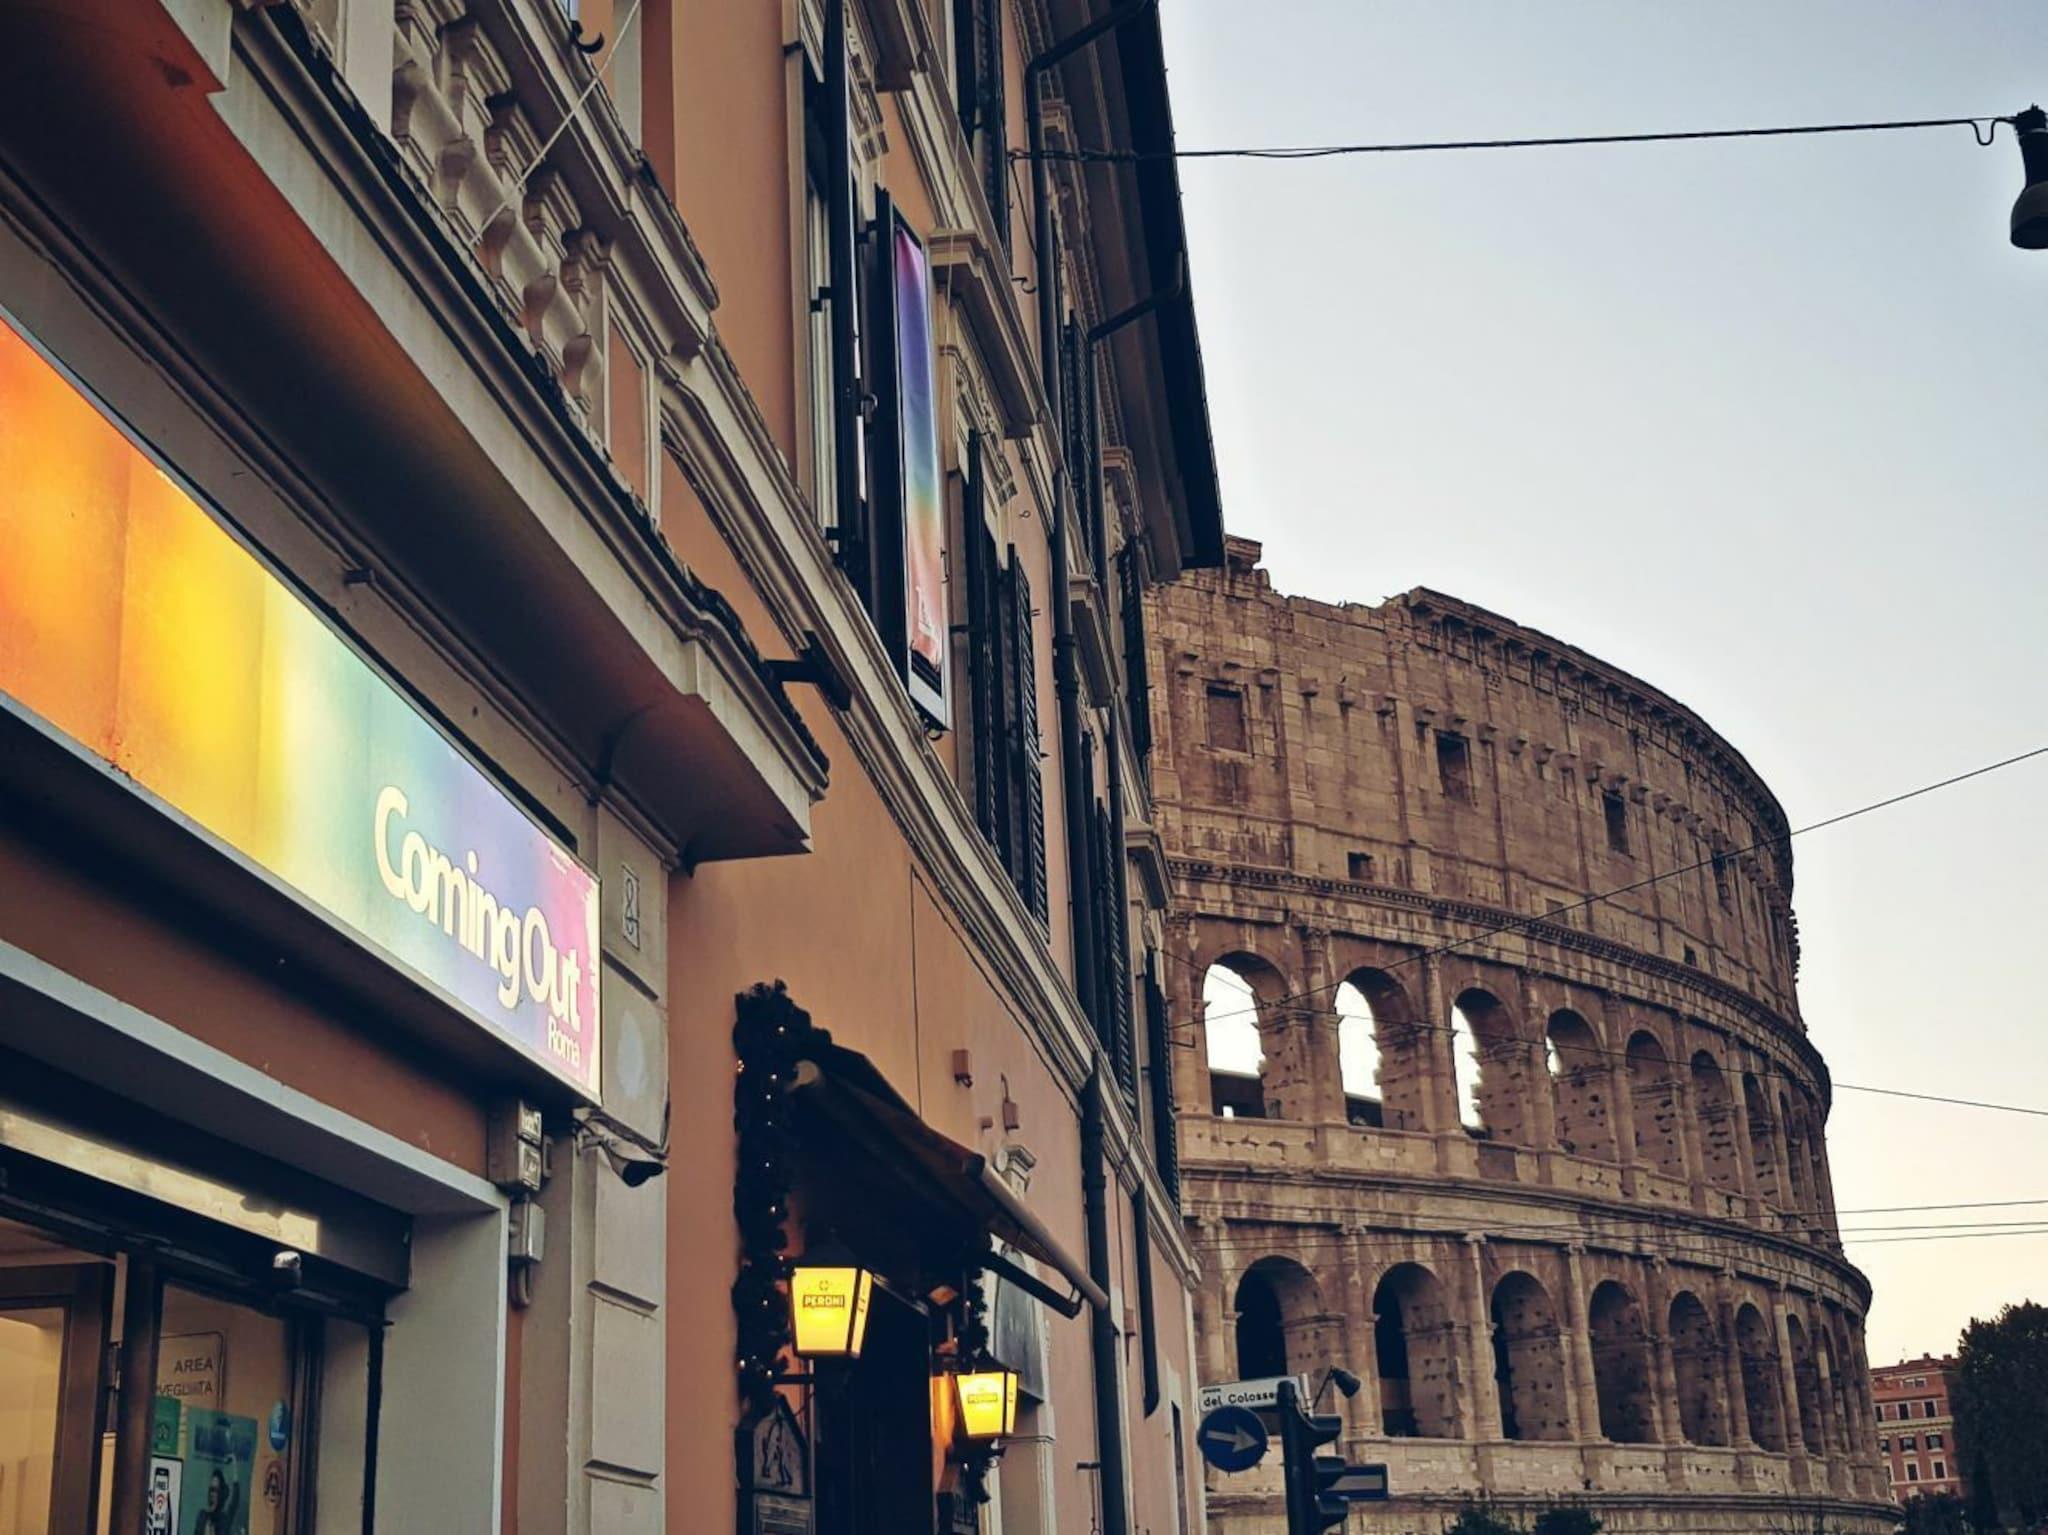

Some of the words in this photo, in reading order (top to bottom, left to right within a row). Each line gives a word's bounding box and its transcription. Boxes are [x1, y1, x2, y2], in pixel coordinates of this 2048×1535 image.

[547, 1015, 582, 1067] Roma
[804, 1295, 844, 1307] PERONI
[174, 1357, 214, 1374] AREA
[1203, 1396, 1223, 1408] del
[1228, 1391, 1275, 1404] Colosse
